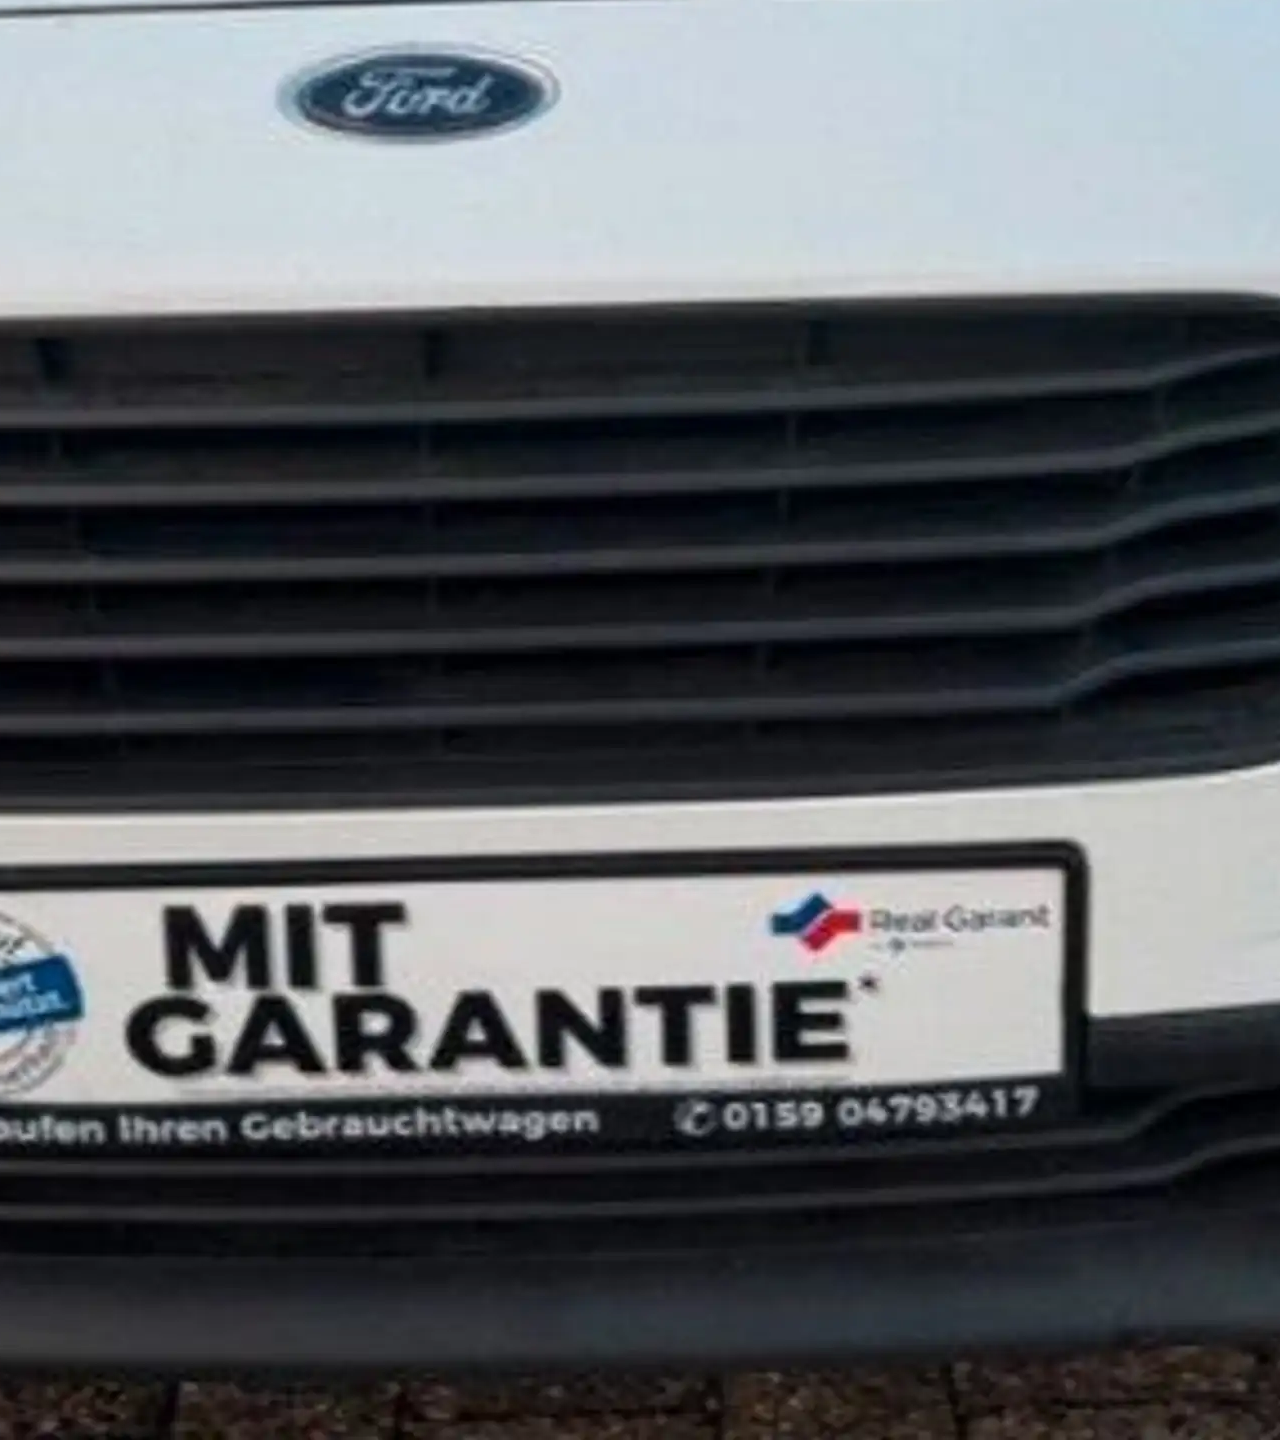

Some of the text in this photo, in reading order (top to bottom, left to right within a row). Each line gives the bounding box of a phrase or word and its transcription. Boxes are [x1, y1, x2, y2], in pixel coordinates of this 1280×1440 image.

[340, 66, 495, 118] Ford
[162, 901, 409, 991] MIT
[121, 1113, 228, 1142] Ihren
[240, 1104, 601, 1142] Gebrauchtwagen
[722, 1101, 824, 1131] 0159
